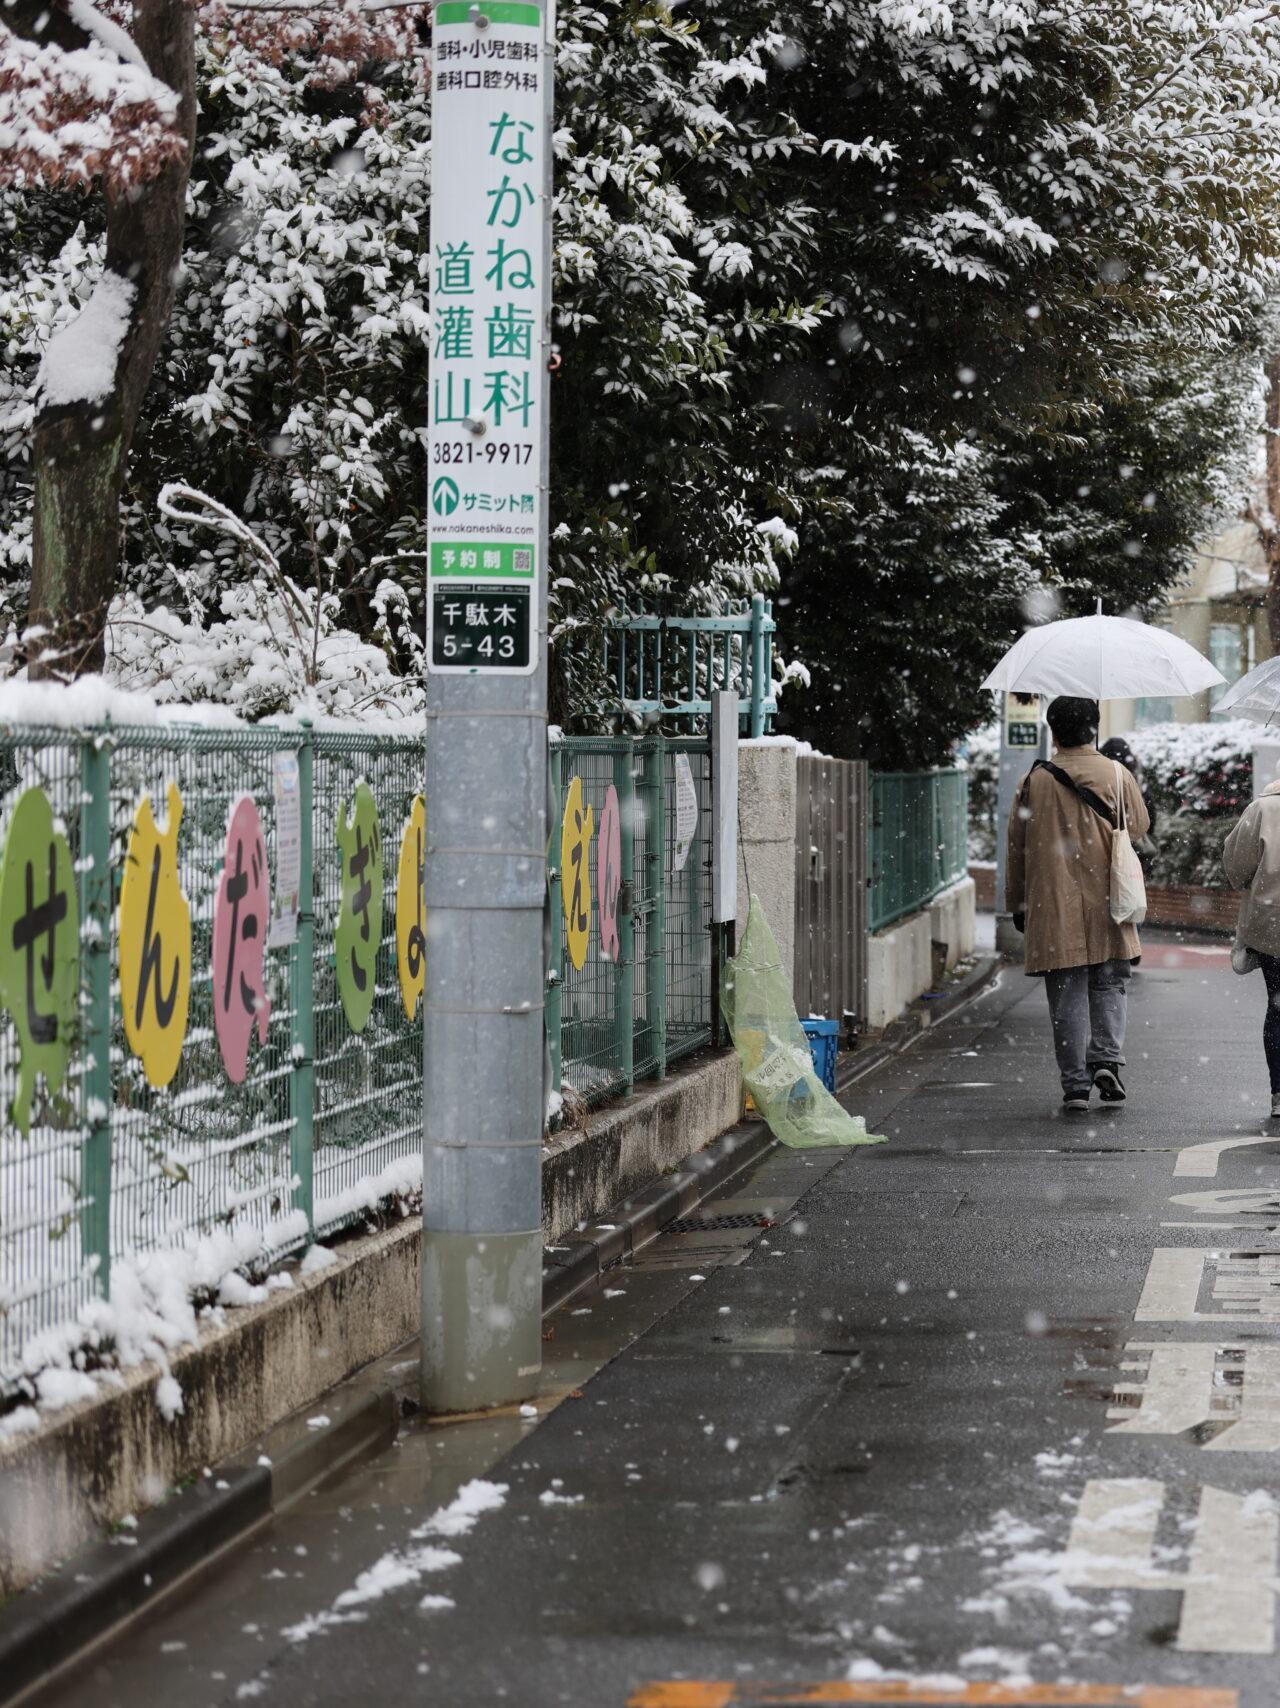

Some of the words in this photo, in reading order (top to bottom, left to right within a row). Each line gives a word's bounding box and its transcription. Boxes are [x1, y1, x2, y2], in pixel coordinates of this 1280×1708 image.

[436, 70, 538, 92] 歯科口腔外科
[482, 112, 535, 428] なかね歯科
[433, 240, 475, 425] 道灌山
[433, 442, 534, 465] 3821-9917
[431, 523, 534, 536] www.nakaneshika.com
[441, 549, 502, 569] 予約制
[442, 602, 517, 627] 千駄木
[442, 634, 515, 658] 5-43
